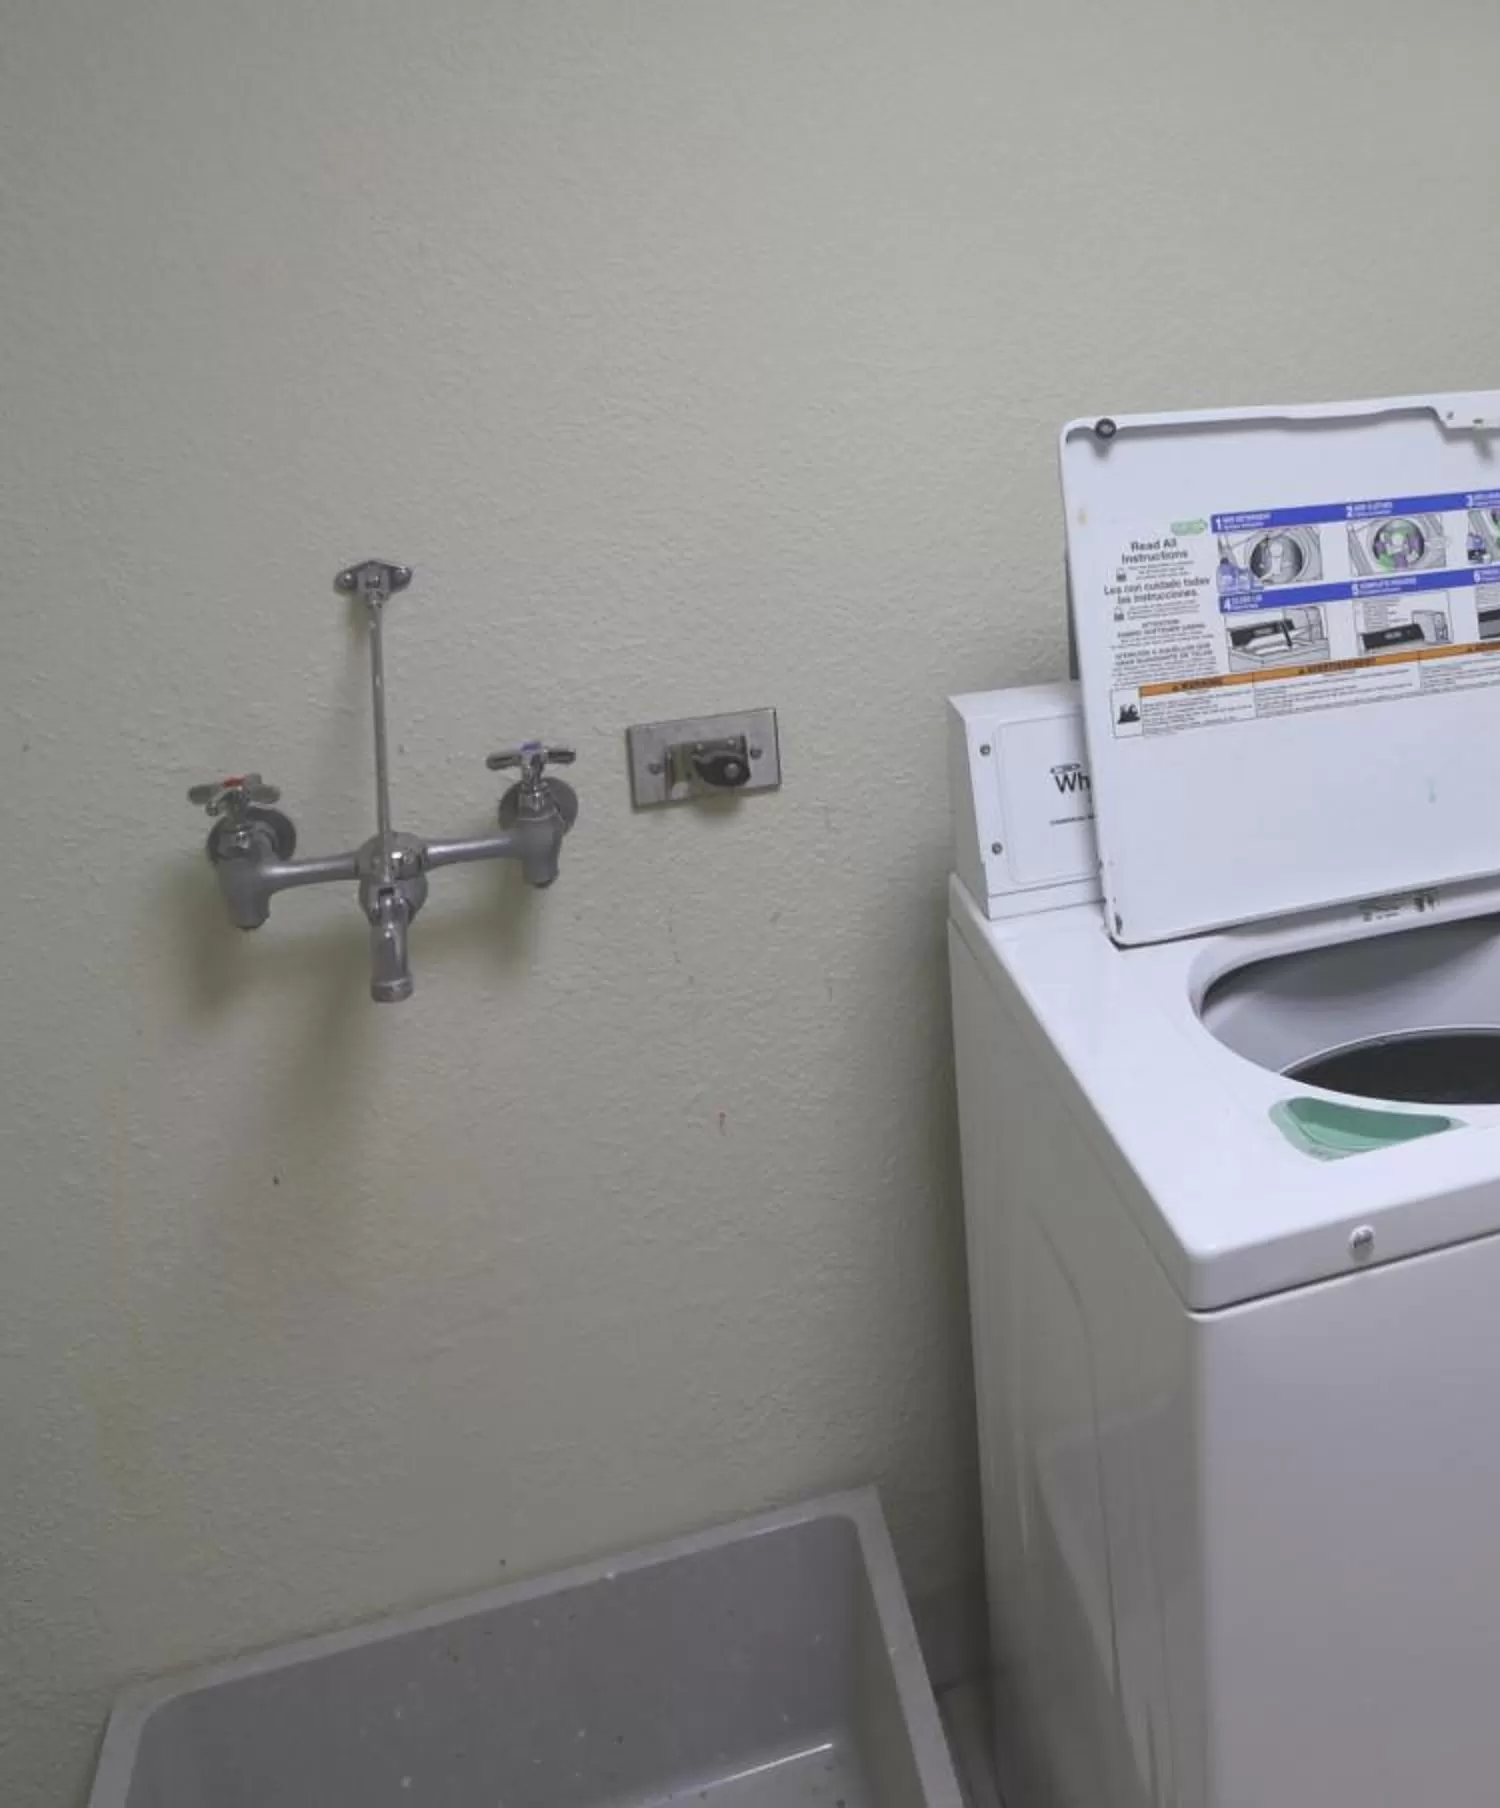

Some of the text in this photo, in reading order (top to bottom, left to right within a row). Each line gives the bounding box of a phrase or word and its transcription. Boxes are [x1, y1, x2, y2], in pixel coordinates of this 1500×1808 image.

[1130, 537, 1178, 553] Read All
[1121, 549, 1188, 565] Instructions
